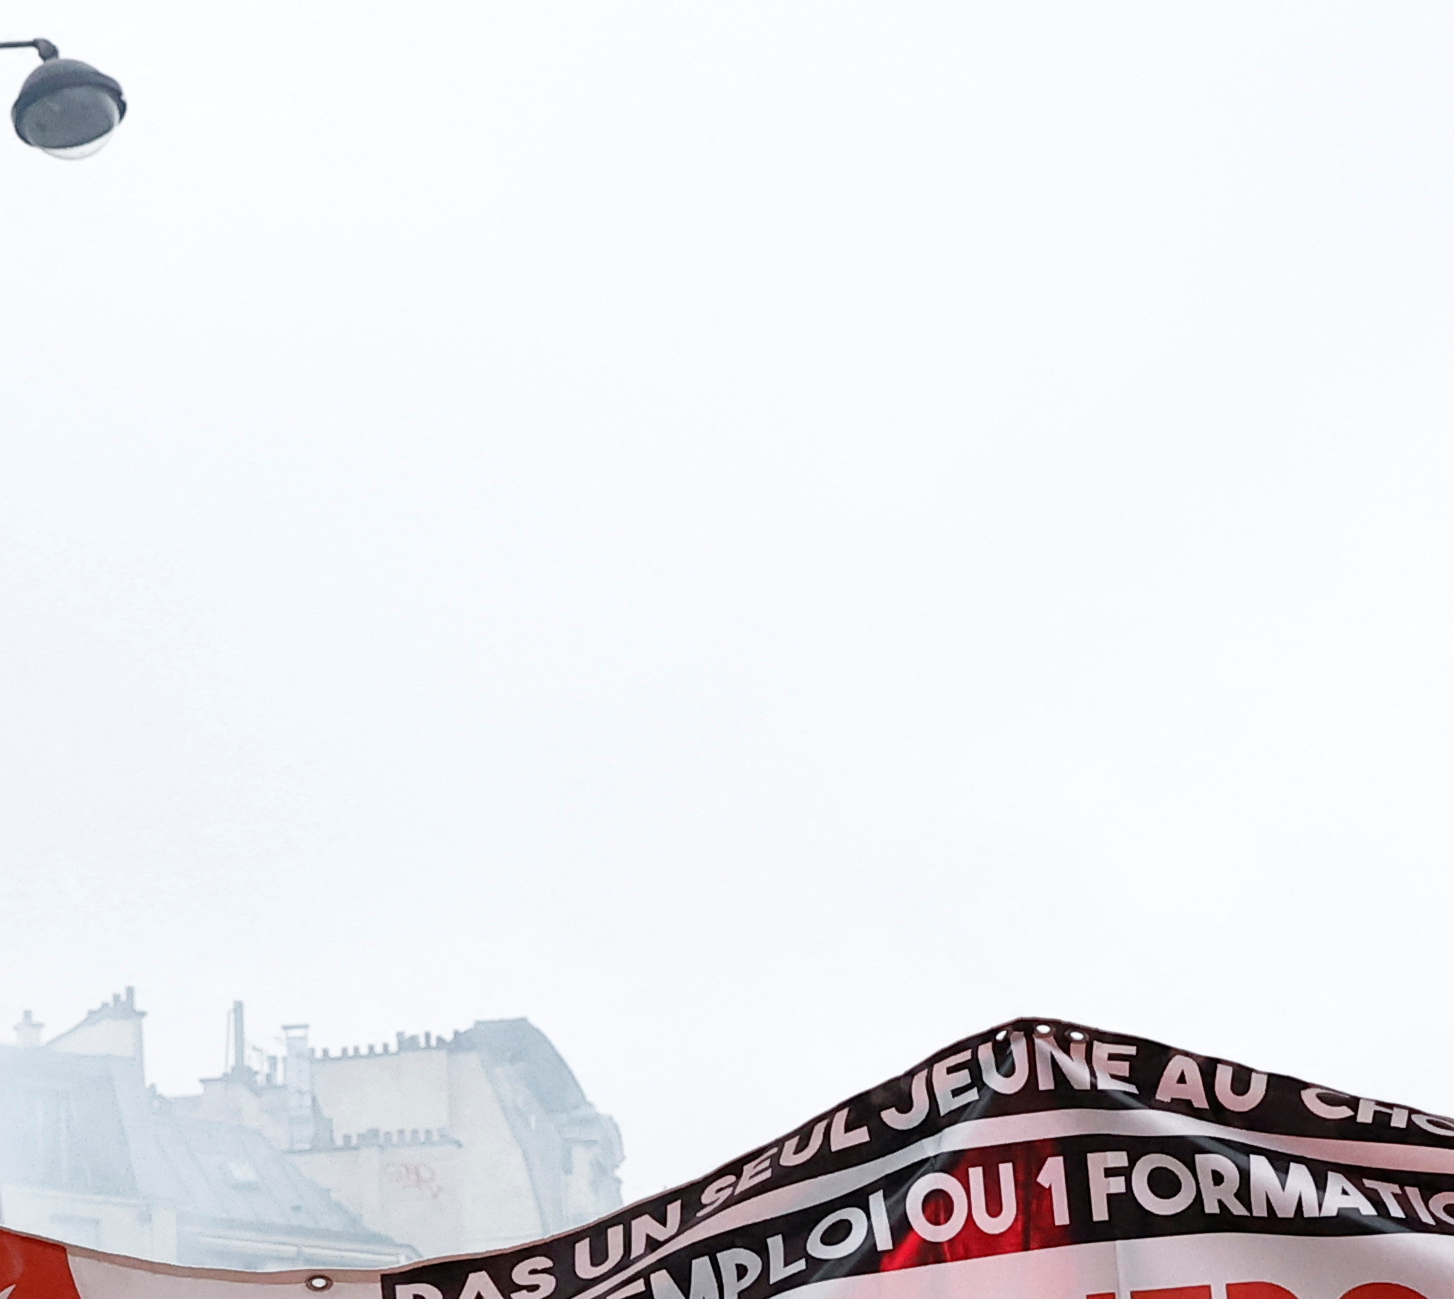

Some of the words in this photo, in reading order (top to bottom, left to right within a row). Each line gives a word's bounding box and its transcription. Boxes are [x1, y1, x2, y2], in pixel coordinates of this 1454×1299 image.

[573, 1199, 682, 1280] UN
[697, 1118, 870, 1217] SEUL
[881, 1033, 1137, 1132] JEUNE
[1155, 1054, 1268, 1113] AU
[905, 1161, 1017, 1244] OU
[1036, 1158, 1071, 1227] 1
